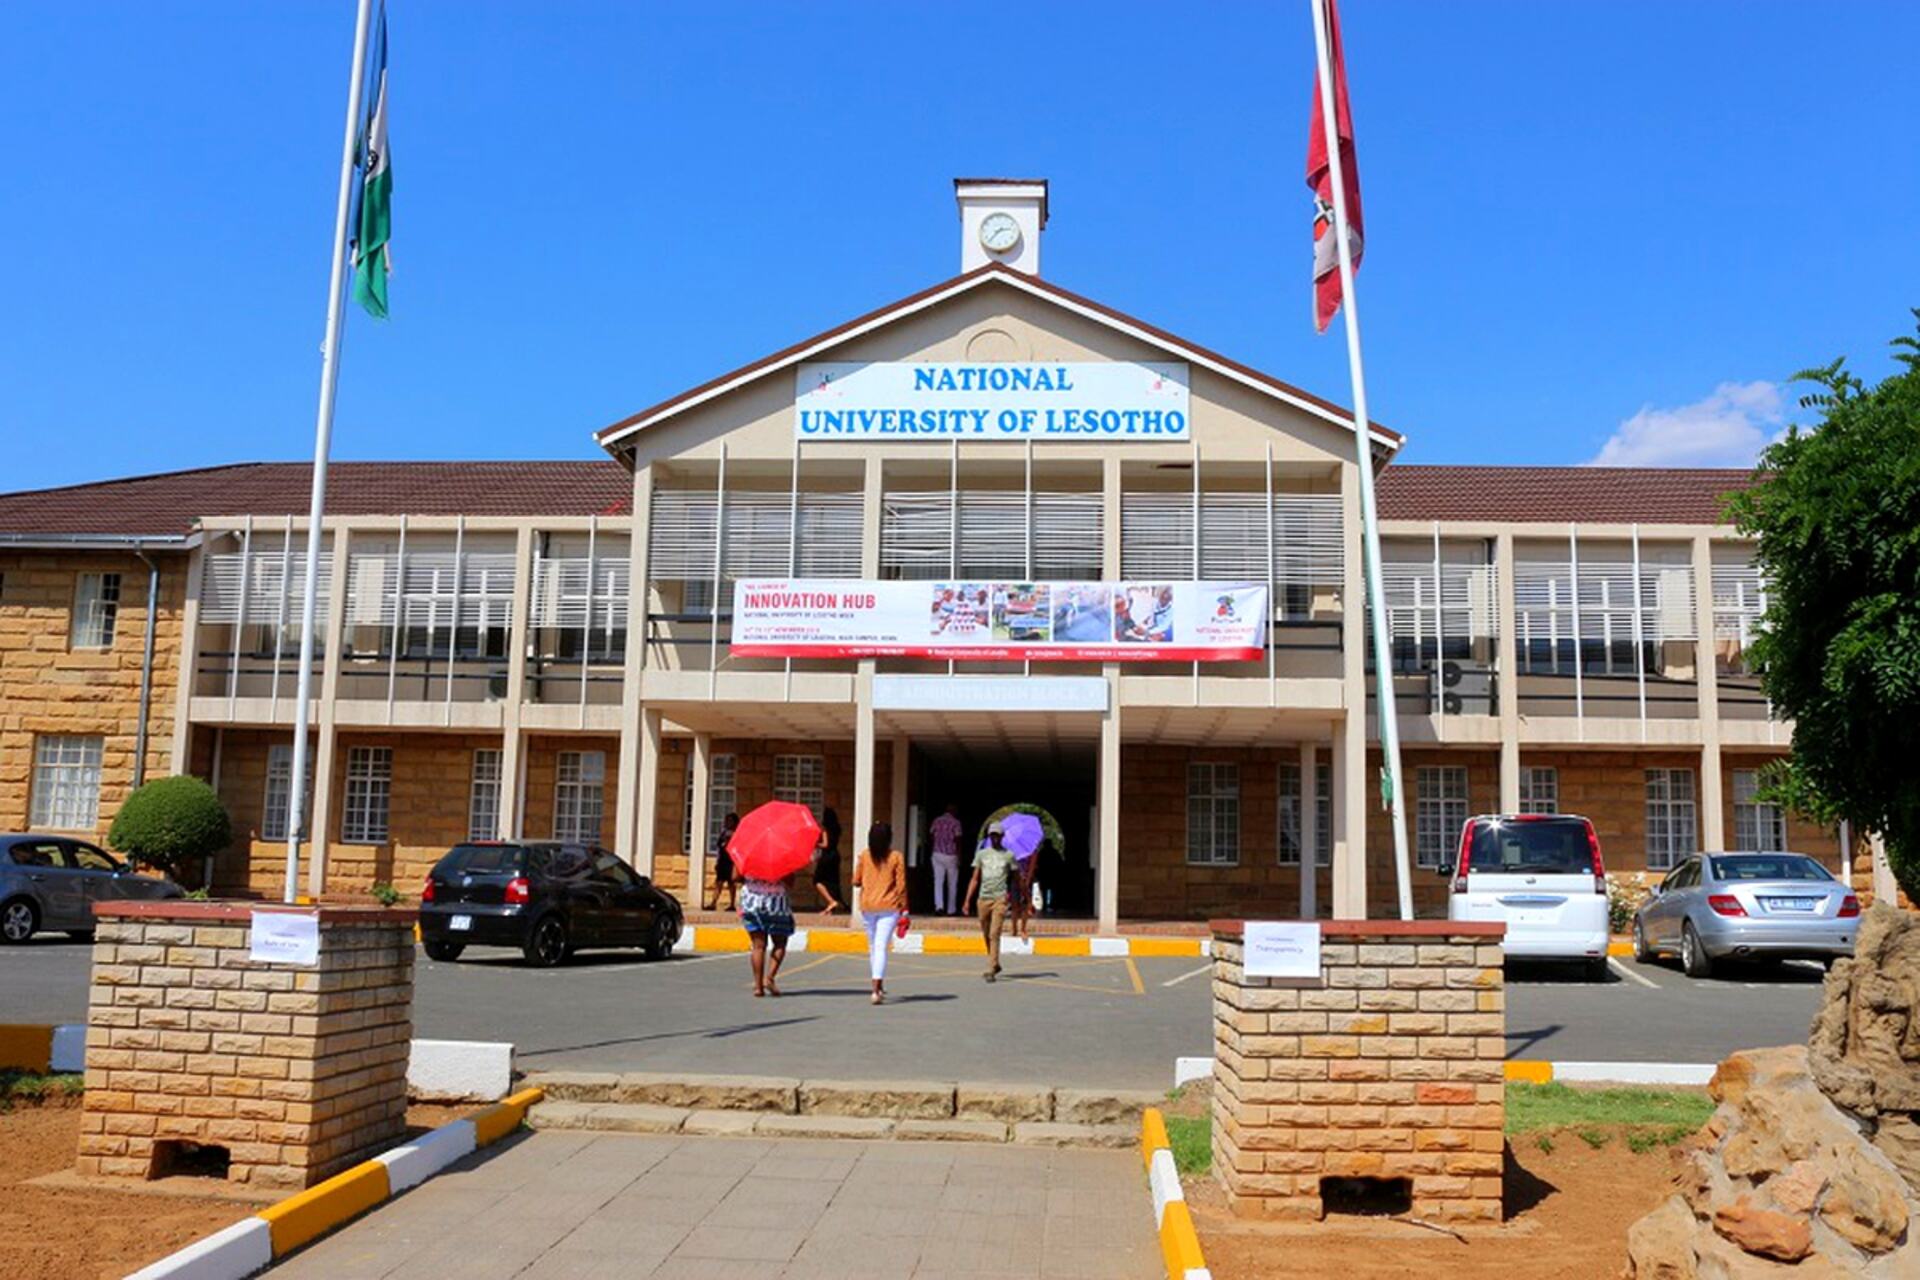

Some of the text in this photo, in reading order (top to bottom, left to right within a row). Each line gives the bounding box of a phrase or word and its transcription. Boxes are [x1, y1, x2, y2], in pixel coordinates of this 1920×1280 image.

[914, 368, 1073, 391] NATIONAL
[800, 409, 1185, 434] UNIVERSITY OF LESOTHO
[744, 593, 876, 609] INNOVATION HUB
